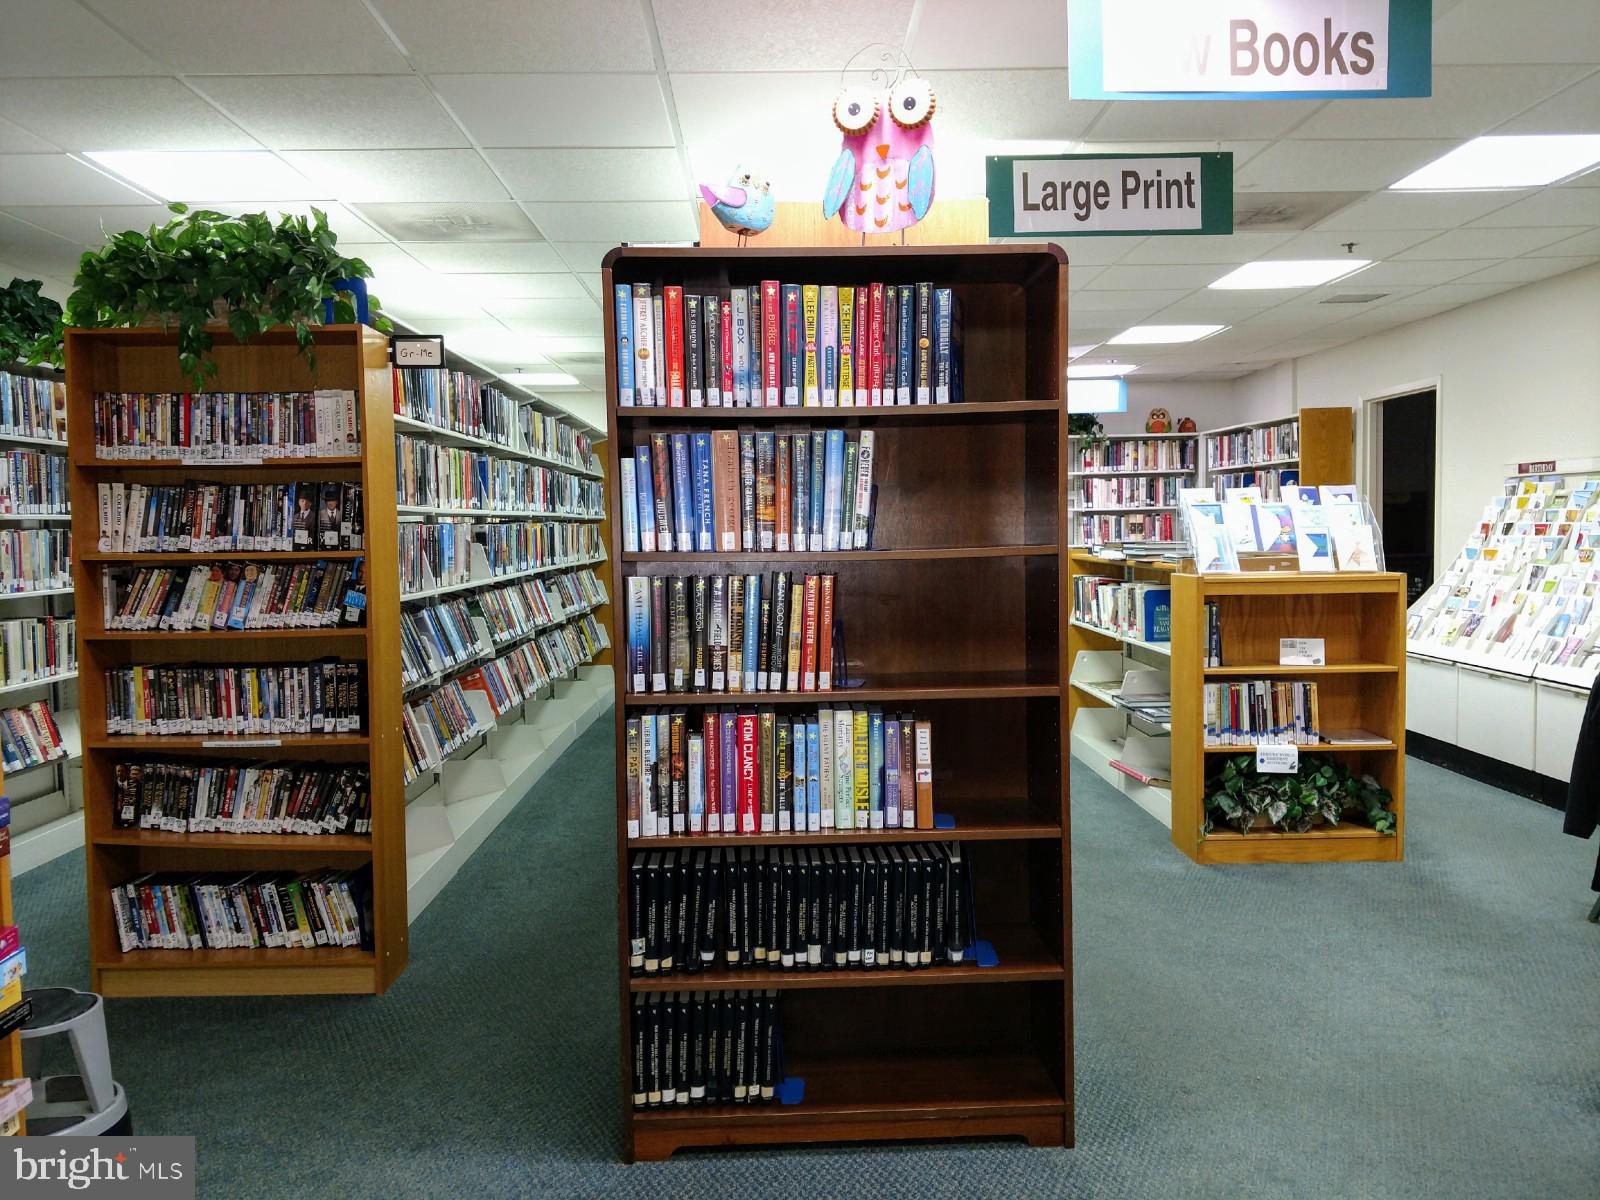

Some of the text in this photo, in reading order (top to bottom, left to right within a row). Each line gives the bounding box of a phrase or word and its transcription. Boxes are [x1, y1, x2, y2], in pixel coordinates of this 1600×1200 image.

[1229, 17, 1375, 76] Books
[1021, 169, 1196, 222] Large Print
[767, 314, 776, 345] BURKE
[841, 320, 851, 341] CHILD
[872, 315, 881, 338] Higgins
[920, 314, 928, 337] CONNELLY
[939, 320, 949, 354] CONNOLLY
[400, 347, 433, 358] Gr-Me
[807, 300, 817, 387] LEE CHILD PAST TENSE
[872, 340, 880, 357] Clark
[842, 358, 850, 371] PAST
[842, 372, 850, 388] TENSE
[346, 400, 354, 431] COLUMBO
[744, 459, 752, 485] HEATHER
[815, 457, 823, 472] Girl
[703, 488, 711, 524] FRENCH
[726, 497, 737, 531] george
[777, 583, 785, 601] EAN
[730, 580, 743, 653] CRAIG JOHNSON
[775, 603, 784, 636] KOONTZ
[713, 629, 722, 646] FIELD
[806, 617, 815, 644] LETHEM
[713, 651, 722, 671] BONES
[743, 723, 753, 741] TOM
[629, 735, 638, 754] EEP
[629, 756, 638, 779] PAST
[743, 744, 753, 781] CLANCY
[854, 712, 869, 812] WALTER MOSLE
